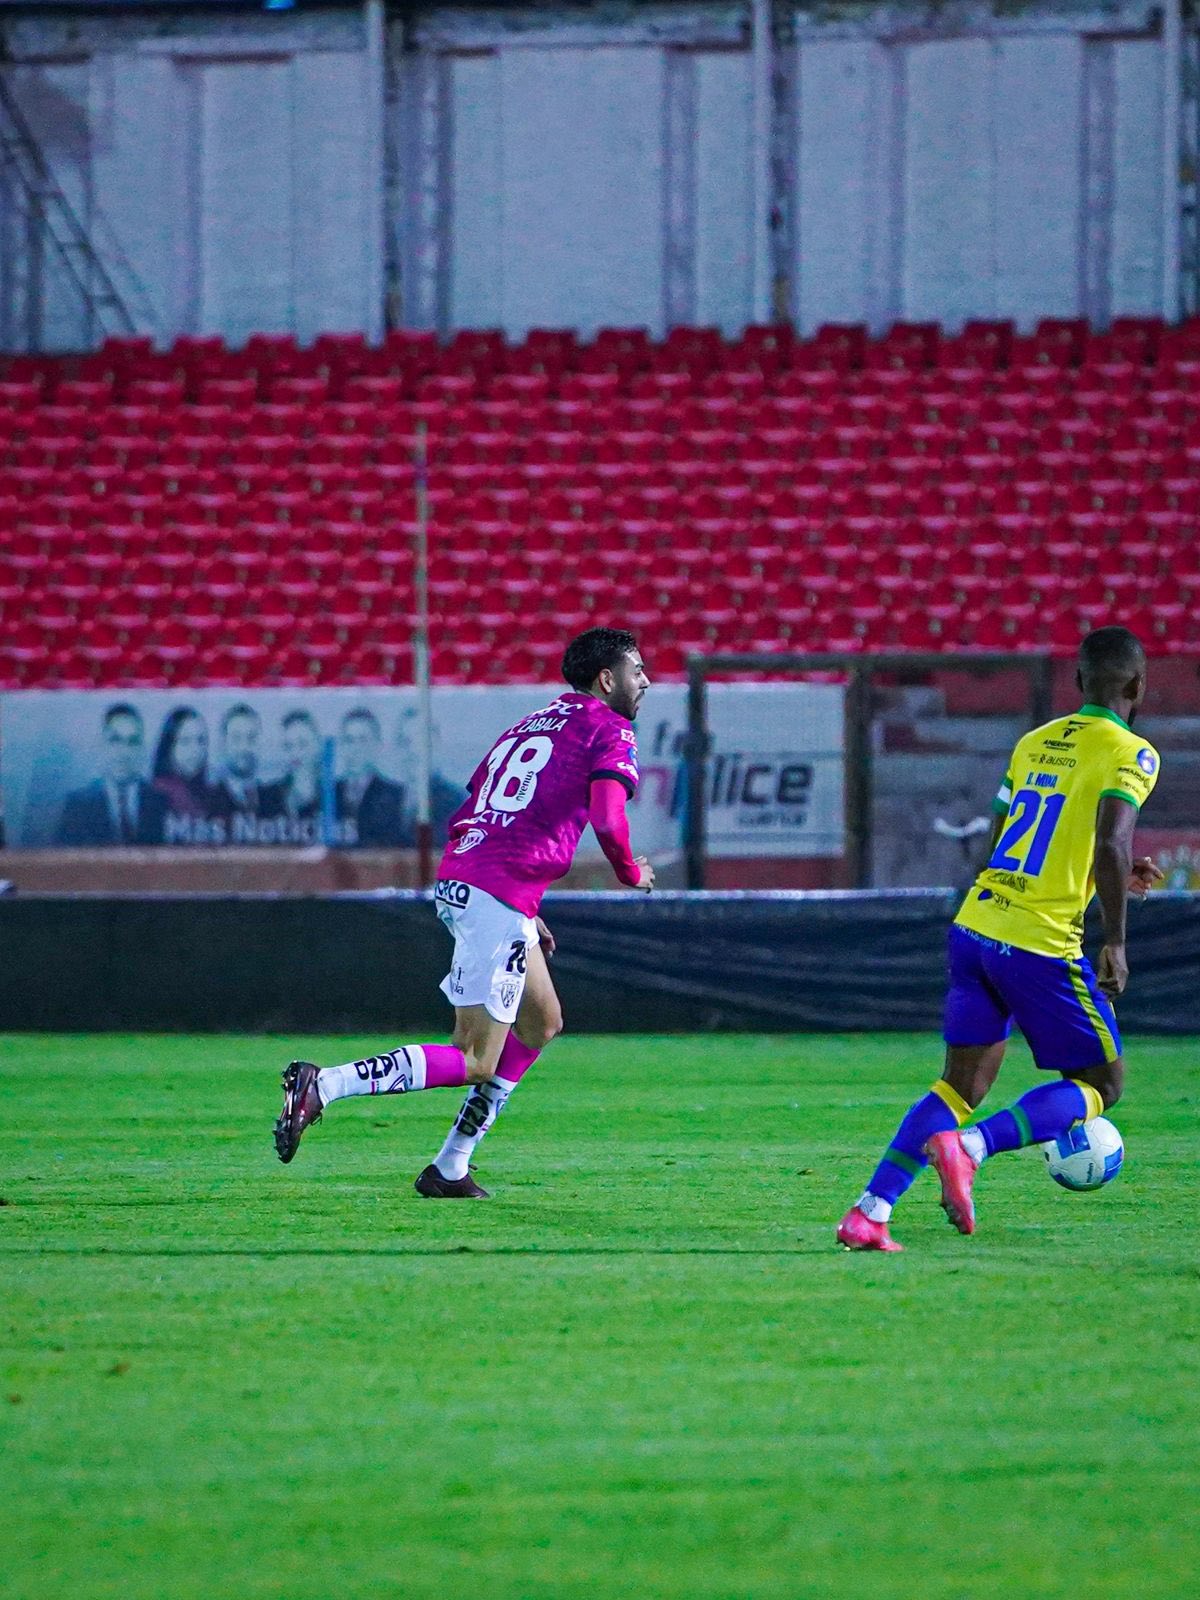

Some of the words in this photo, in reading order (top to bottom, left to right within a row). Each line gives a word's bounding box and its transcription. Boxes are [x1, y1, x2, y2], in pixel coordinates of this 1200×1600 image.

[517, 717, 568, 734] ZABALA
[474, 735, 554, 813] 18
[988, 789, 1067, 876] 21
